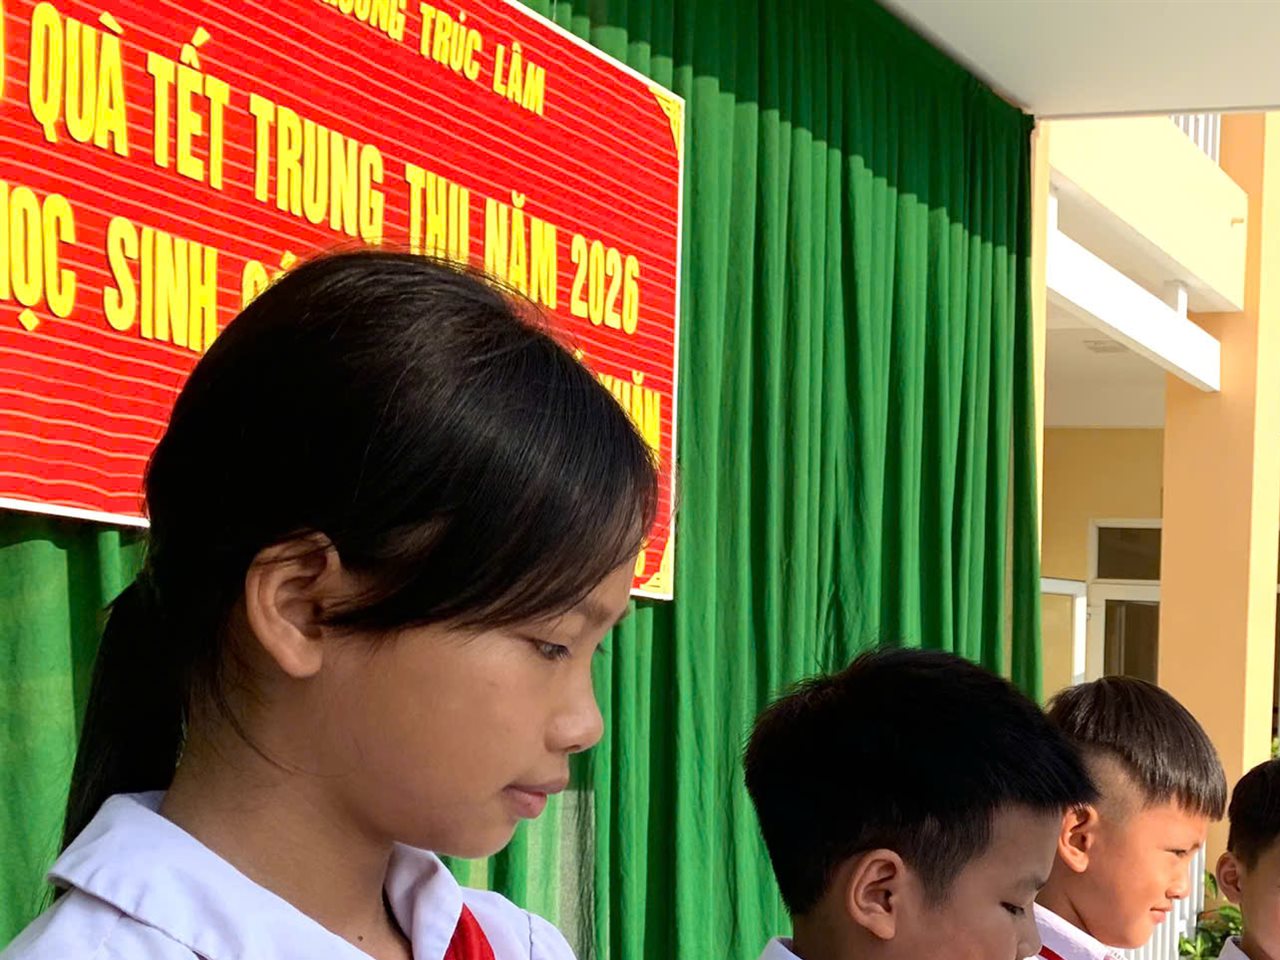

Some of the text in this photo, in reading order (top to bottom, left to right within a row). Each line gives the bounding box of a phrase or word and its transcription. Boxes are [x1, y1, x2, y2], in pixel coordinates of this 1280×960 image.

[419, 2, 482, 81] TRÚC
[492, 41, 546, 116] LÂM
[29, 2, 129, 157] QUÀ
[147, 26, 230, 190] TẾT
[249, 92, 385, 246] TRUNG
[484, 189, 557, 310] NĂM
[571, 234, 640, 335] 2026
[103, 216, 218, 353] SINH
